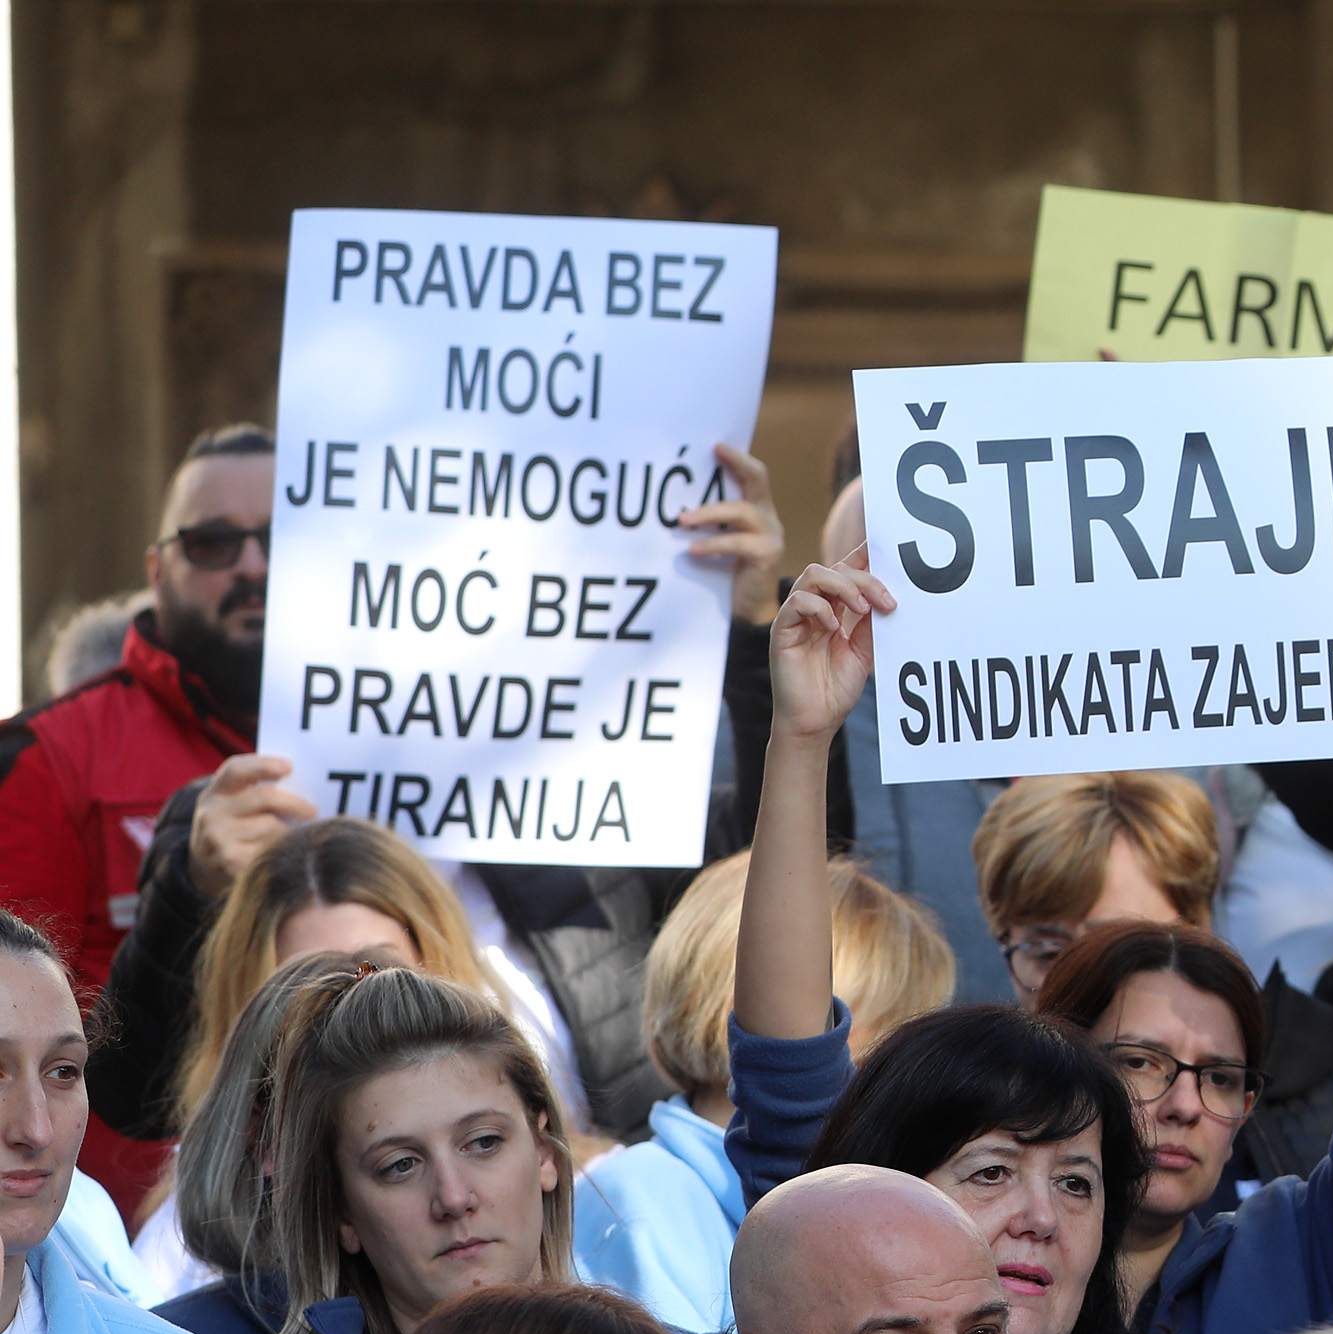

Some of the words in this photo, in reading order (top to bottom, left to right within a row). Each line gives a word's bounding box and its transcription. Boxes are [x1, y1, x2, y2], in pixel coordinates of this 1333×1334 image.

[332, 239, 584, 314] PRAVDA
[605, 253, 727, 323] BEZ
[445, 333, 603, 421] MOĆI
[286, 441, 357, 508] JE
[349, 551, 497, 637] MOĆ
[526, 574, 658, 642] BEZ
[300, 665, 582, 741] PRAVDE
[601, 679, 682, 742] JE
[899, 648, 1179, 746] SINDIKATA
[328, 772, 631, 842] TIRANIJA
